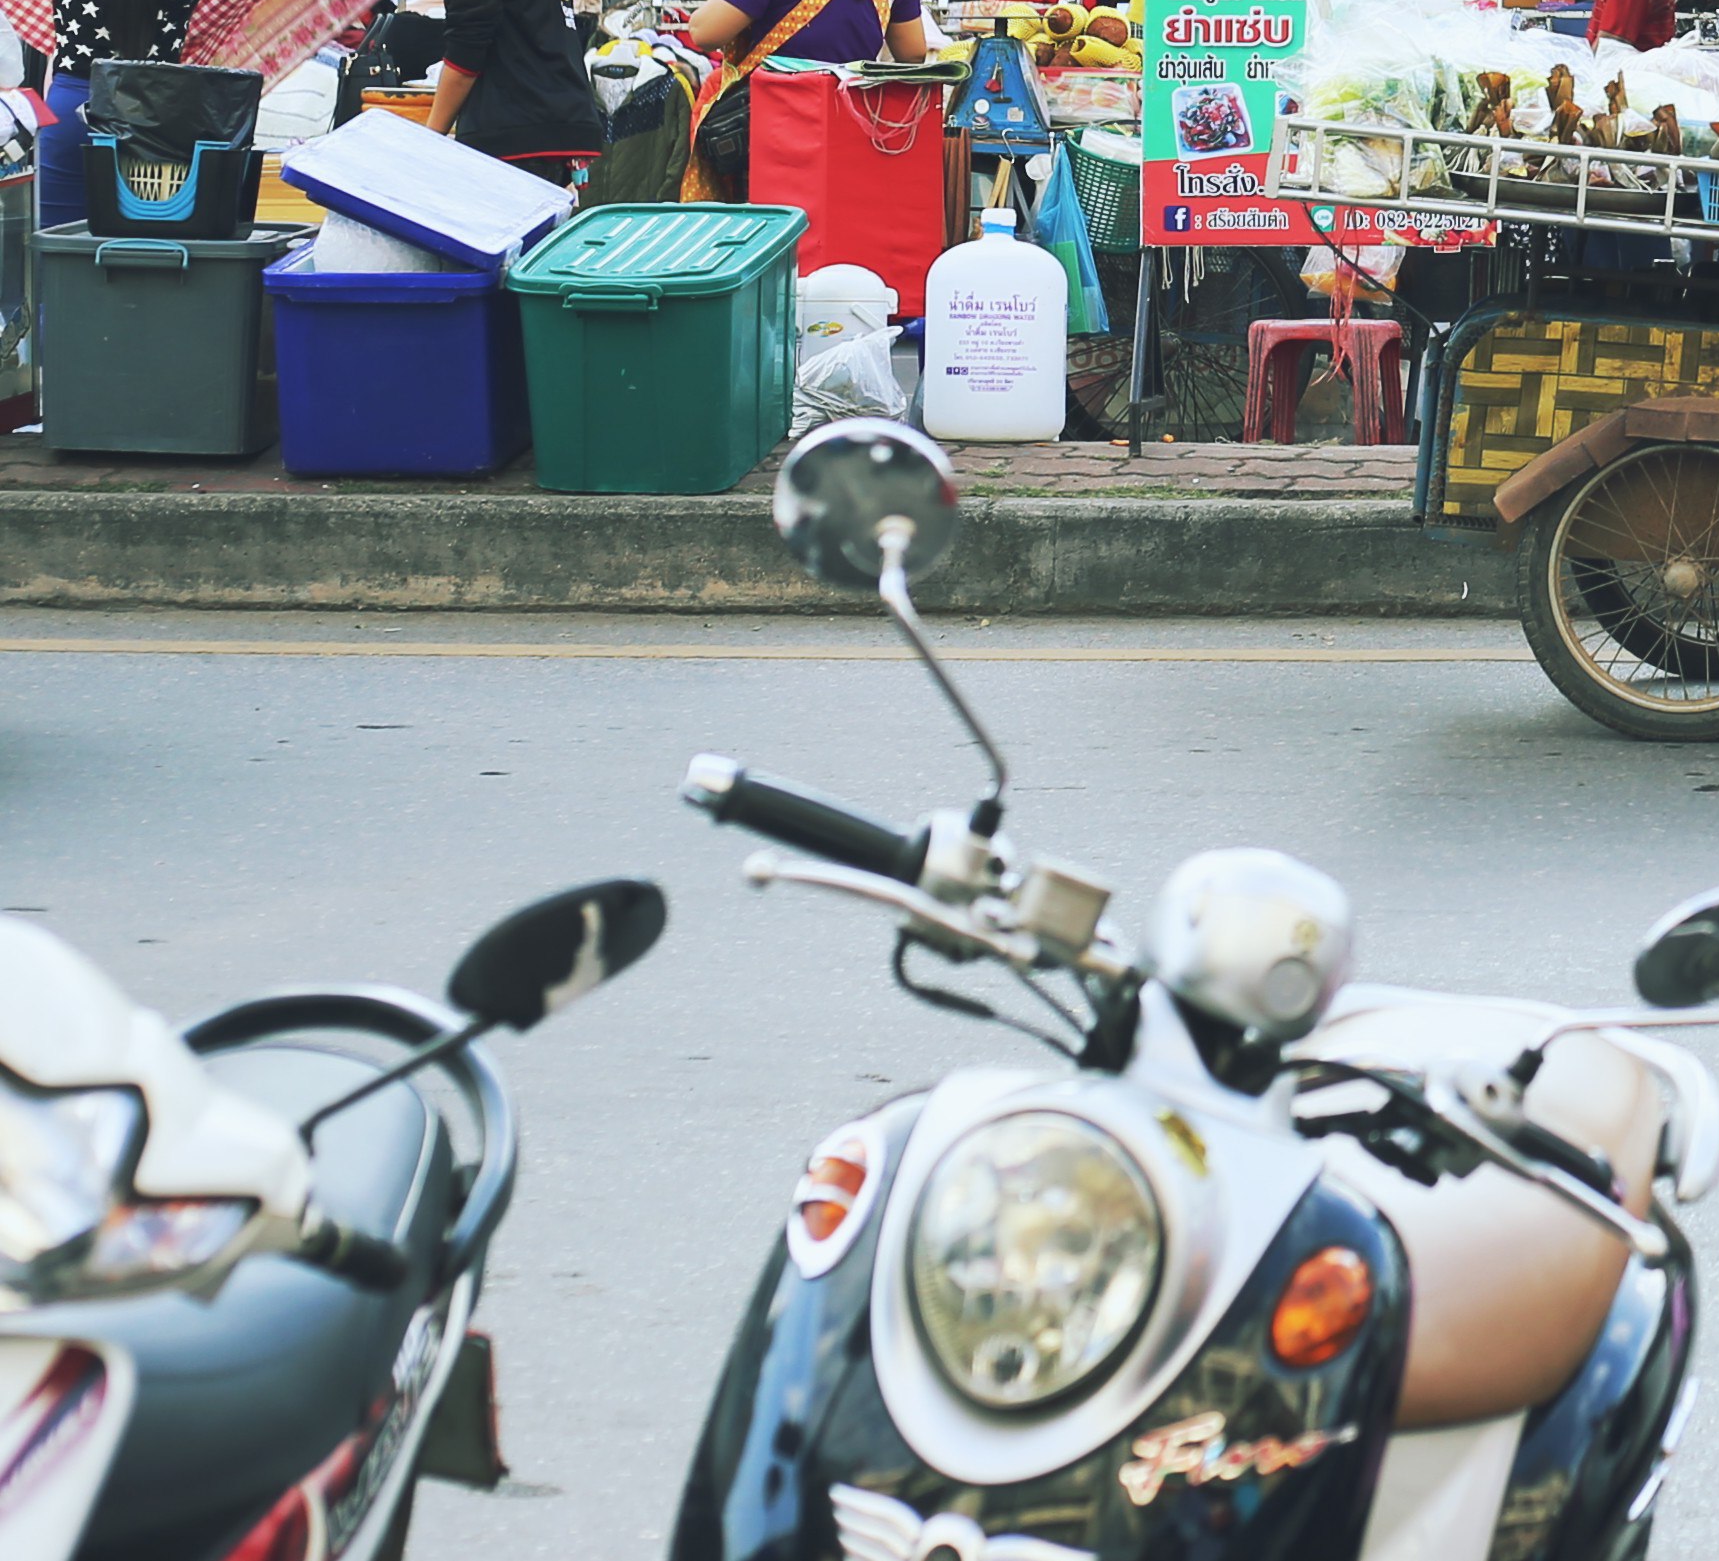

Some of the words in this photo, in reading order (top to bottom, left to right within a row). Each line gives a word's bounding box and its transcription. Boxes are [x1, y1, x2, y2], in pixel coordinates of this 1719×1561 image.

[1164, 7, 1291, 46] ยำแซ่บ
[1157, 54, 1225, 85] ยำวุ้นเส้น
[1206, 206, 1289, 231] สร้อยส้มตำ
[949, 289, 984, 312] น้ำดื่ม
[990, 294, 1037, 313] เรนโบว์
